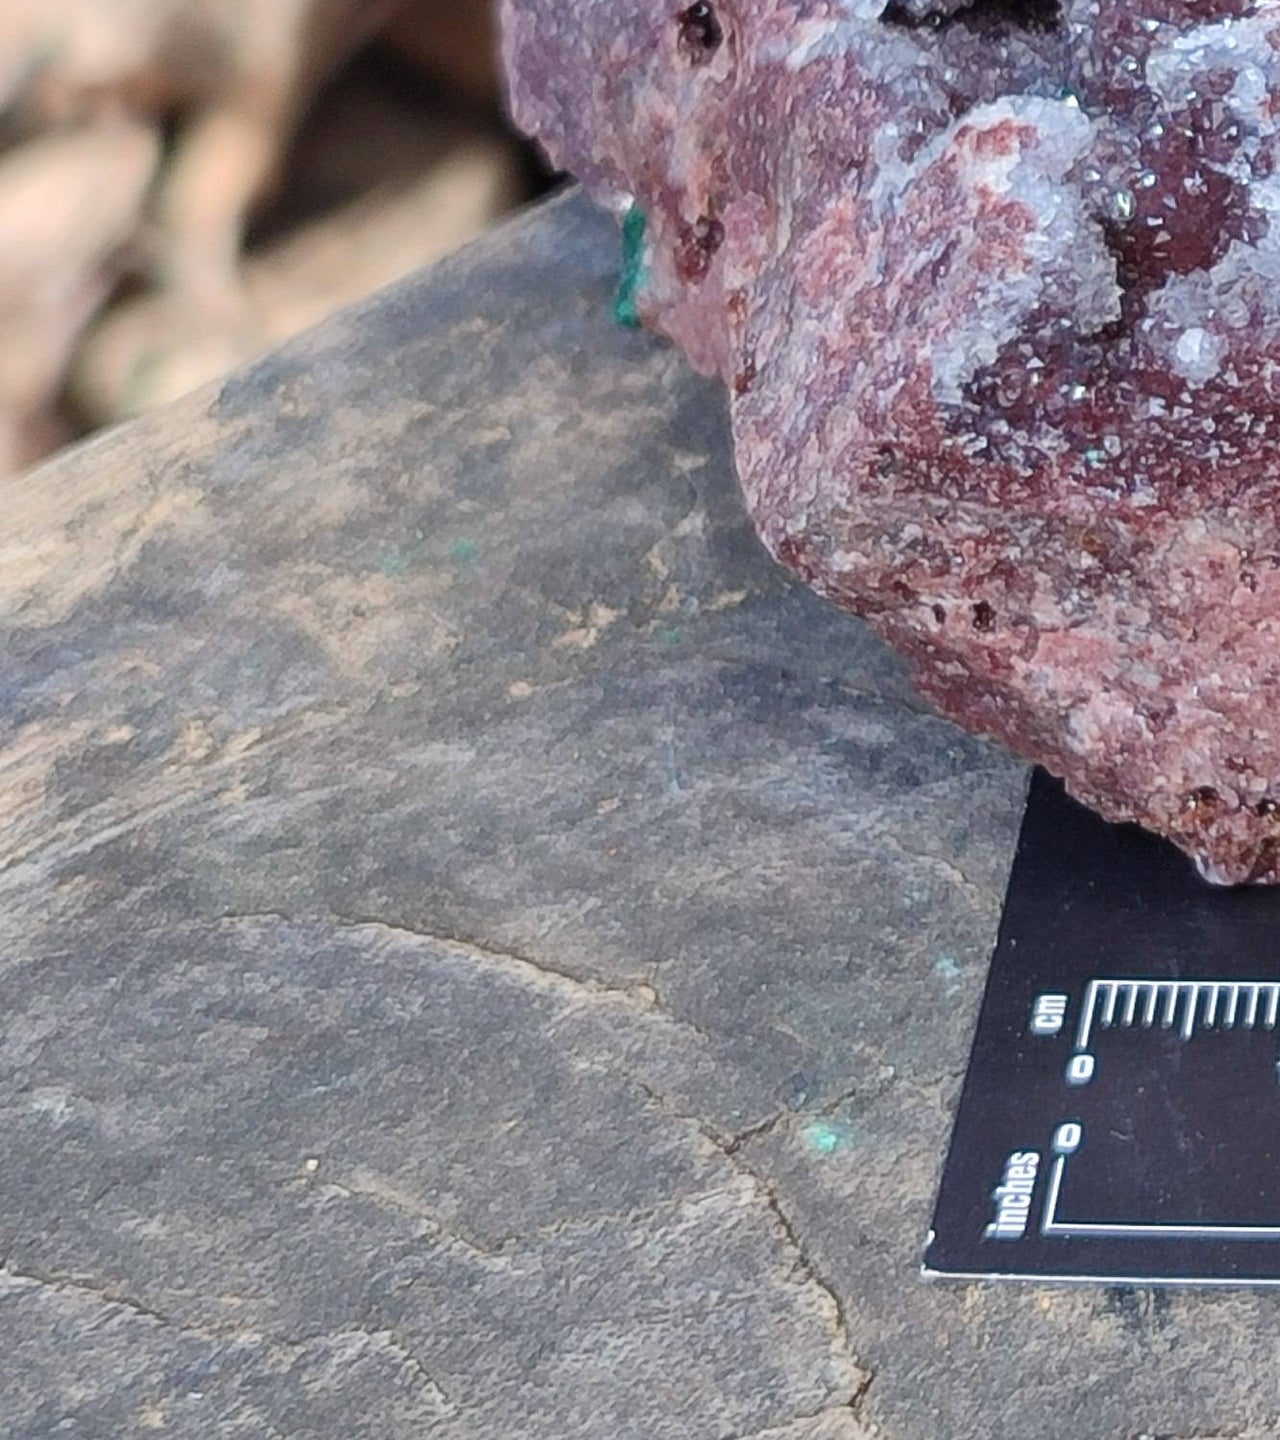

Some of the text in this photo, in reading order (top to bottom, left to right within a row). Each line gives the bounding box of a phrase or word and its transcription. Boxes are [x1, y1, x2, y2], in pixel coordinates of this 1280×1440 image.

[1031, 994, 1068, 1033] cm
[1067, 1054, 1095, 1082] 0
[1054, 1122, 1082, 1151] 0
[986, 1151, 1040, 1238] inches
